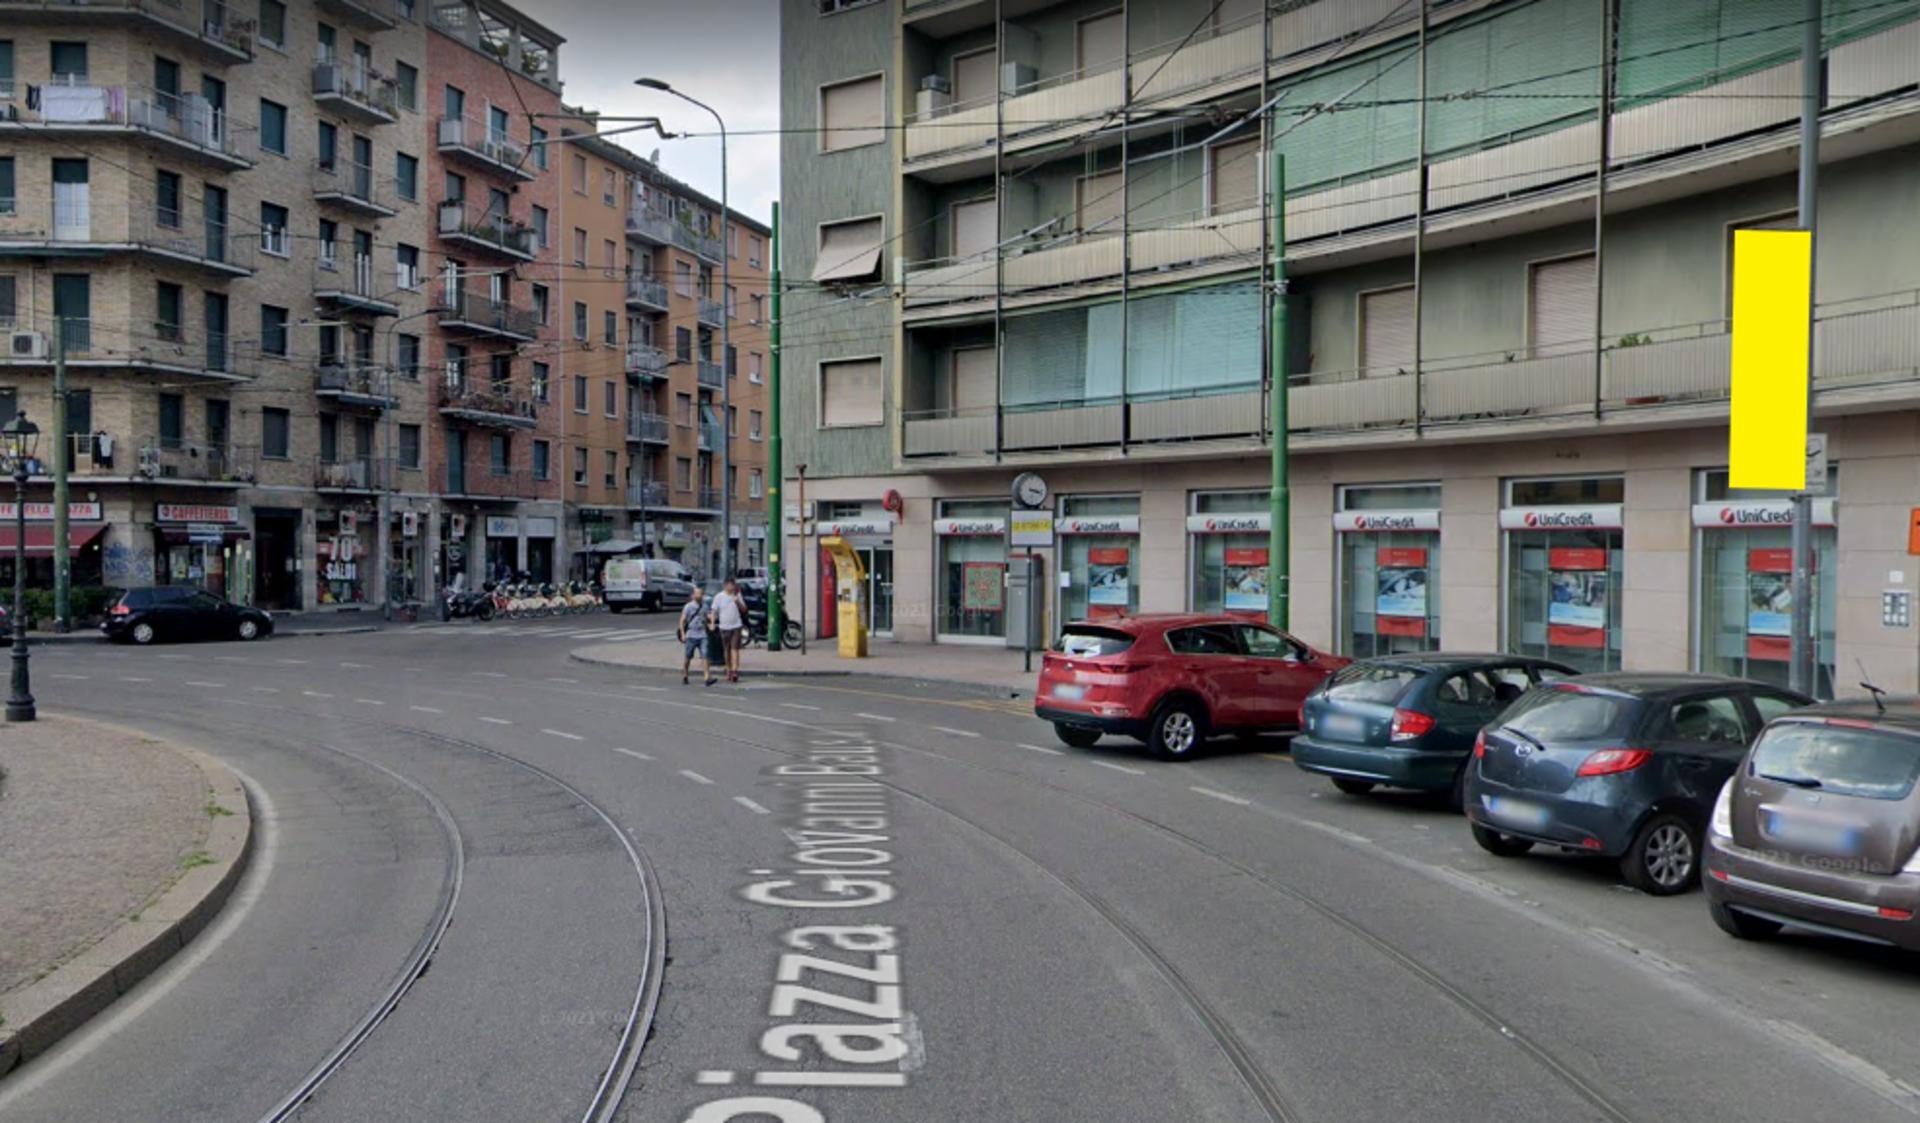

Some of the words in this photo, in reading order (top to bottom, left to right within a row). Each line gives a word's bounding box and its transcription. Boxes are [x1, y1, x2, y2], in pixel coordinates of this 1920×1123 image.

[24, 504, 49, 514] ELLA
[1218, 519, 1259, 529] UniCredit
[1367, 516, 1415, 528] UniCredit
[1538, 512, 1594, 526] UniCredit
[958, 522, 993, 531] UniCredit
[1081, 521, 1121, 531] UniCredit
[326, 563, 356, 580] SALDI
